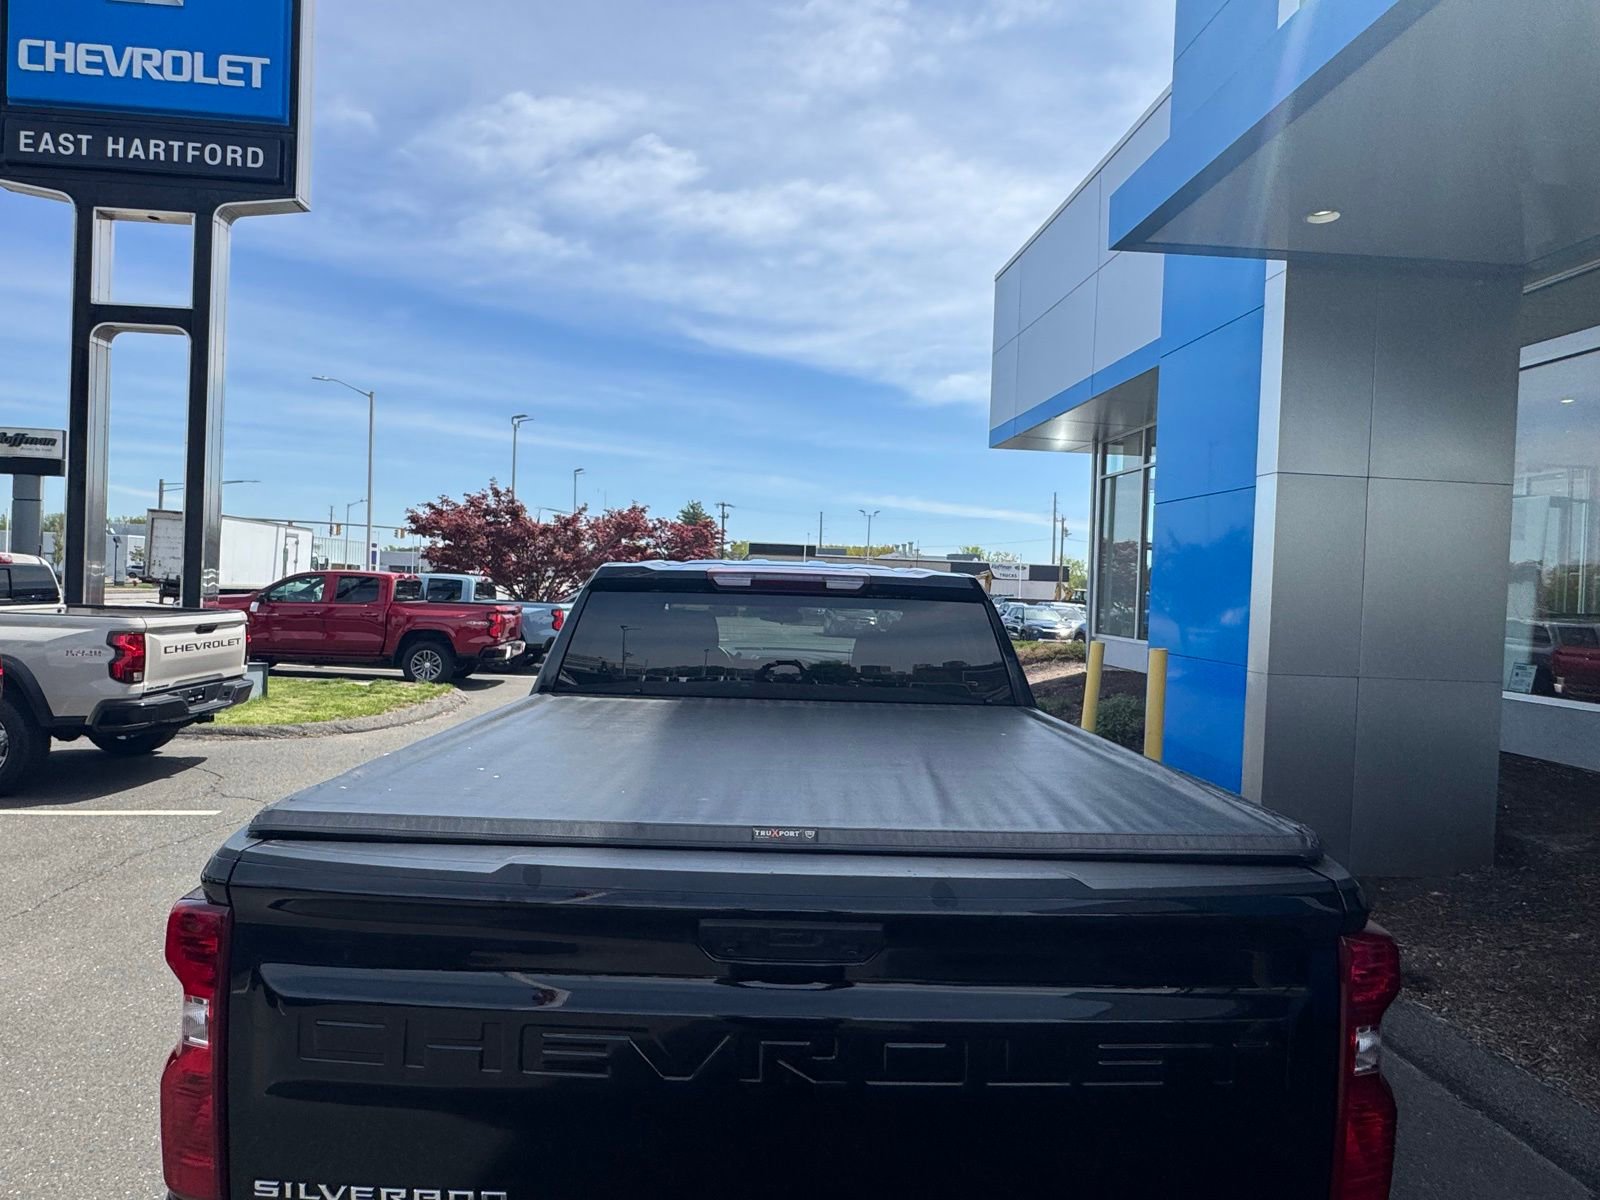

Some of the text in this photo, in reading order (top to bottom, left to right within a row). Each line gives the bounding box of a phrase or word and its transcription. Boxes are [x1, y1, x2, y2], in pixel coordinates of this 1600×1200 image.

[18, 38, 270, 88] CHEVROLET
[19, 130, 264, 168] EAST HARTFORD
[0, 432, 57, 447] offman
[164, 637, 241, 654] CHEVROLET
[295, 1014, 1274, 1088] CHEVROLET
